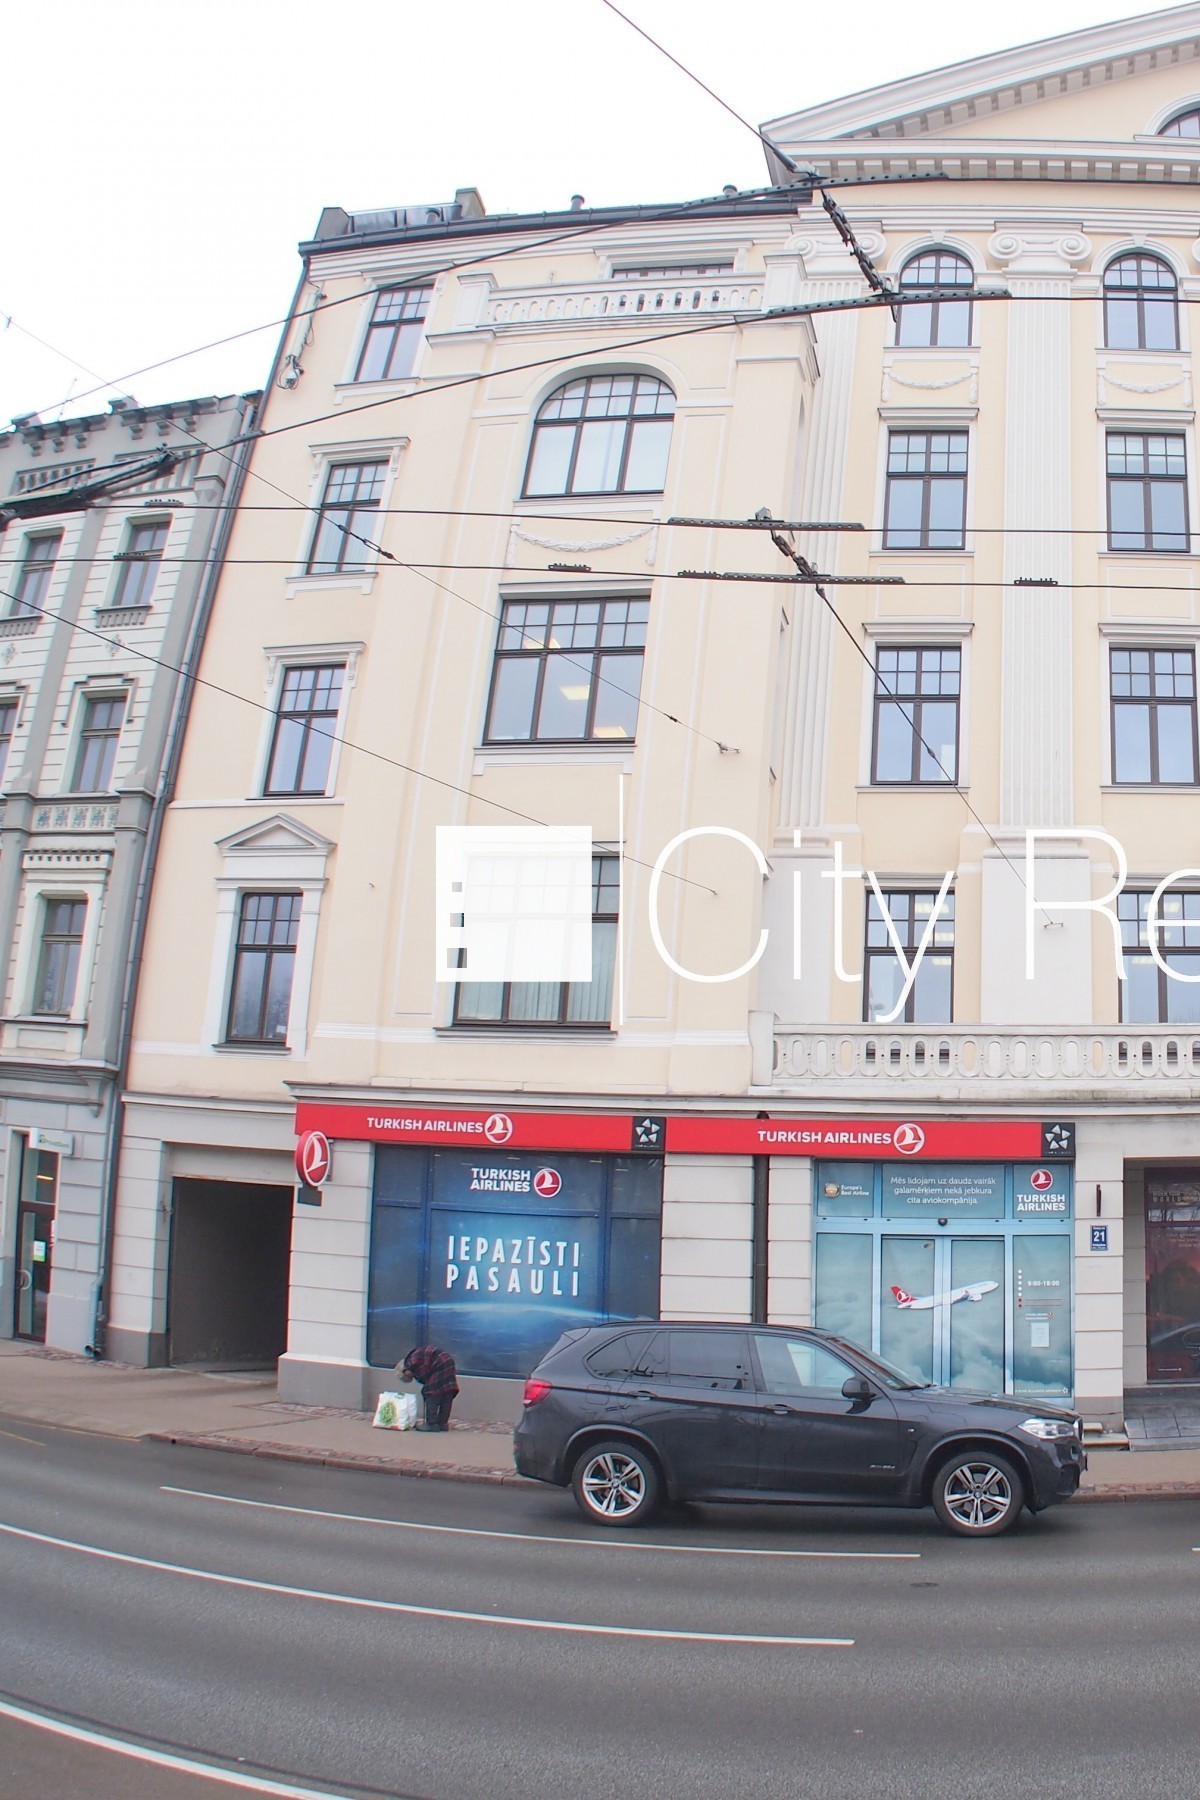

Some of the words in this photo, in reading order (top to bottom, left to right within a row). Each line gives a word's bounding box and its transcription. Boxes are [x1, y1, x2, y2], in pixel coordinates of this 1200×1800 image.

[366, 1117, 422, 1131] TURKISH
[423, 1119, 484, 1134] AIRLINES
[757, 1129, 822, 1144] TURKISH
[823, 1130, 892, 1146] AIRLINES
[470, 1167, 531, 1181] TURKISH
[469, 1178, 531, 1193] AIRLINES
[890, 1176, 906, 1185] Mēs
[907, 1176, 936, 1186] lidojam
[948, 1177, 973, 1185] daudz
[973, 1177, 996, 1185] vairāk
[944, 1187, 963, 1195] nekā
[963, 1187, 992, 1196] jebkura
[906, 1196, 921, 1204] cita
[1016, 1193, 1066, 1204] TURKISH
[1016, 1202, 1066, 1212] AIRLINES
[1093, 1230, 1105, 1242] 21
[447, 1235, 581, 1268] IEPAZĪSTI
[445, 1263, 579, 1297] PASAULI
[1027, 1279, 1060, 1287] 9:00-18:00
